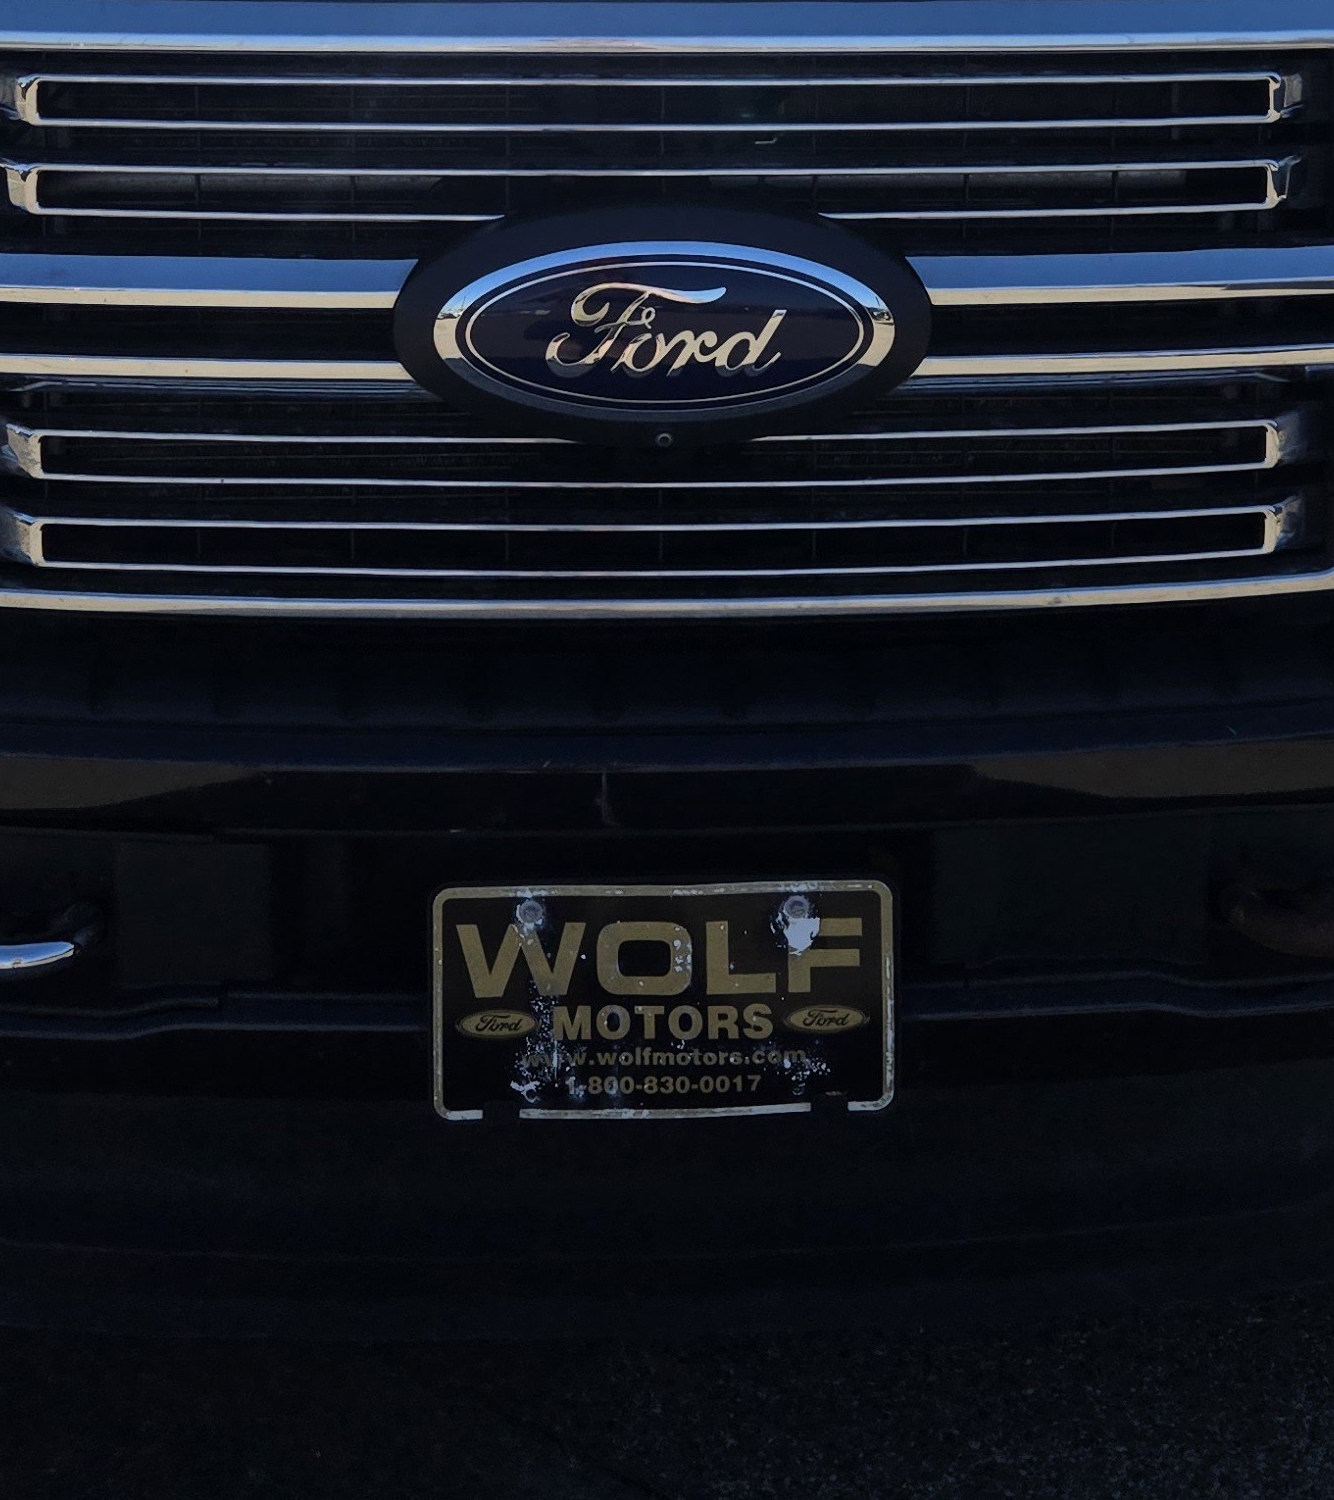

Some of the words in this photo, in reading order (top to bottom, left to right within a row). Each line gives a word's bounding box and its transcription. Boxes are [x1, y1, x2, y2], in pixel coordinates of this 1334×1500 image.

[546, 281, 788, 376] Ford
[456, 917, 863, 999] WOLF
[475, 1014, 524, 1033] Ford
[552, 1003, 774, 1041] MOTORS
[802, 1009, 851, 1028] Ford
